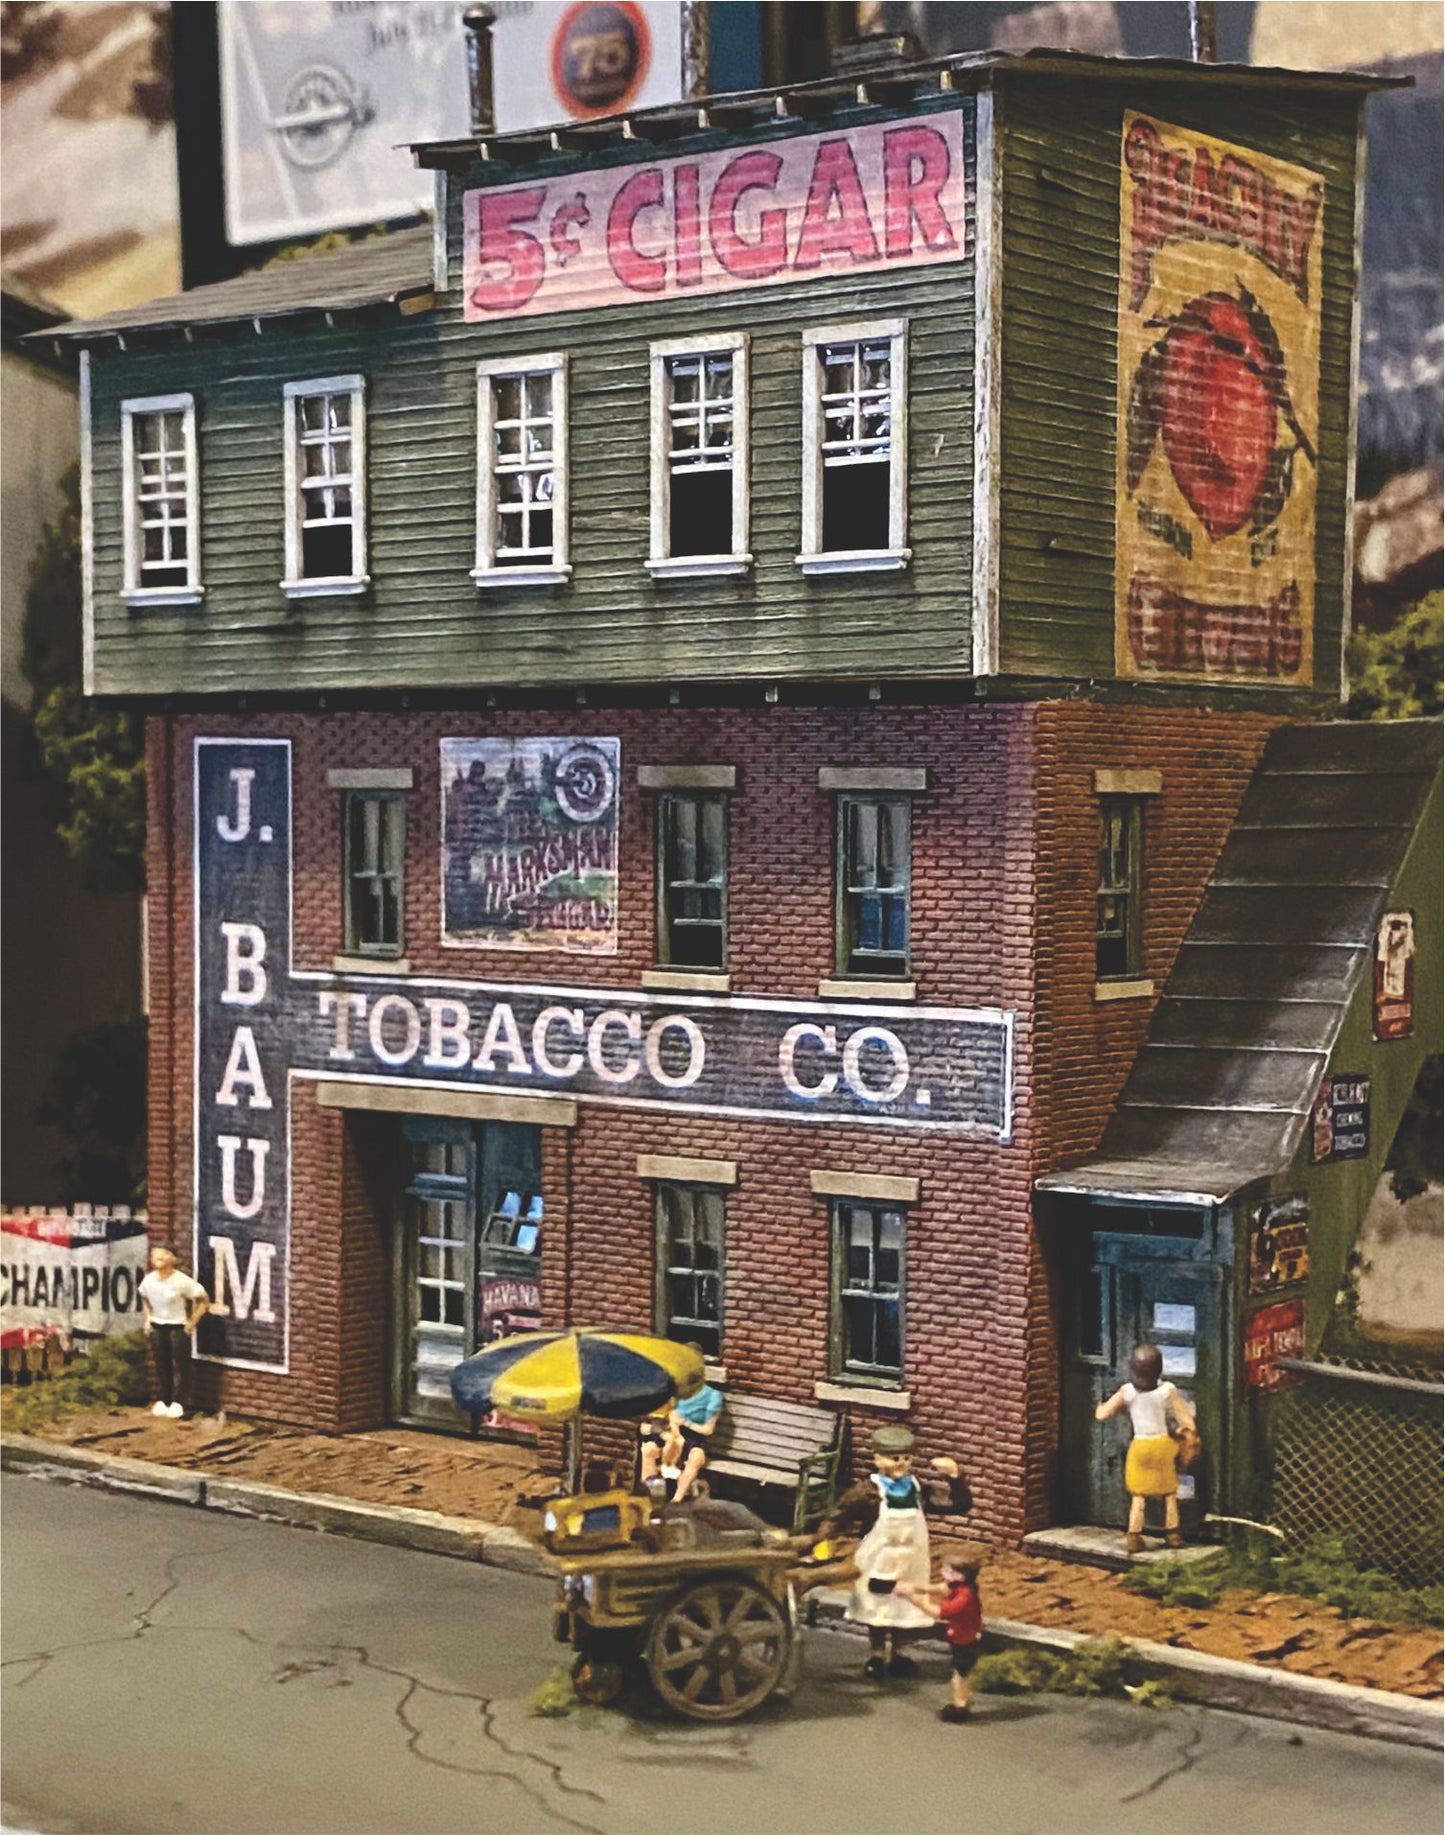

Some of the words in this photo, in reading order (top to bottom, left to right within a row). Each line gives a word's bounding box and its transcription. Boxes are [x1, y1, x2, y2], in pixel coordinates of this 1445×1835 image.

[471, 186, 591, 311] 5¢
[606, 125, 959, 293] CIGAR
[216, 769, 273, 843] J.
[207, 921, 276, 1323] BAUM
[318, 991, 706, 1088] TOBACCO
[778, 1023, 932, 1105] CO.
